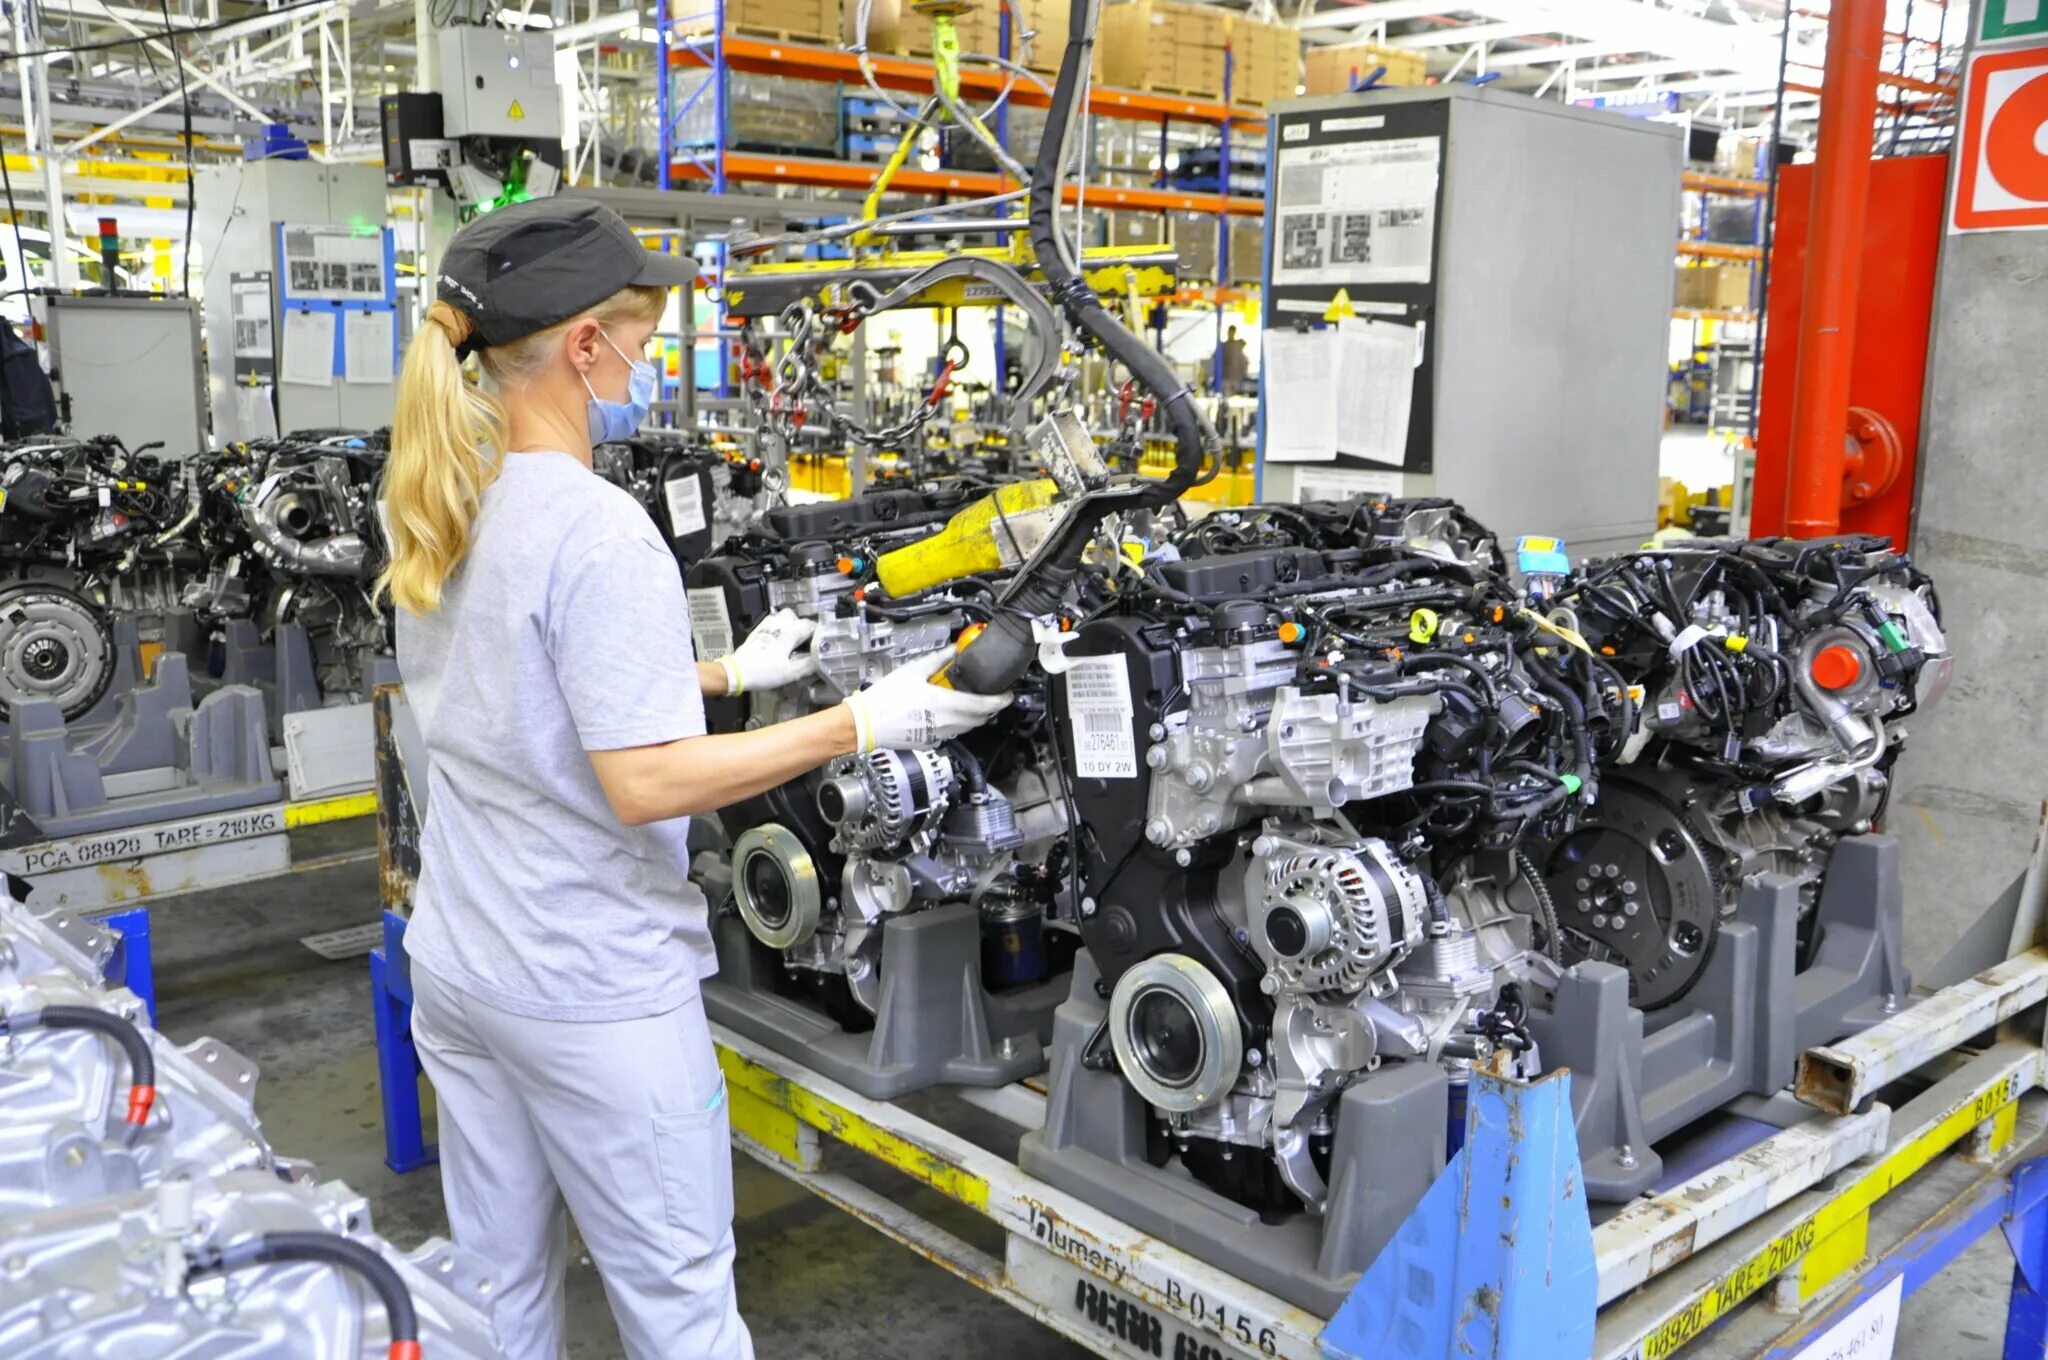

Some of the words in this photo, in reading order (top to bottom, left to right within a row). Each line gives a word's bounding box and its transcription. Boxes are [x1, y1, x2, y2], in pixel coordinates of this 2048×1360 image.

[1098, 761, 1111, 772] DY
[1115, 761, 1131, 772] 2W
[25, 849, 71, 872] PCA
[78, 838, 141, 861] 08920
[154, 825, 202, 849] TARE
[219, 820, 248, 838] 210
[251, 814, 276, 831] KG
[1714, 1263, 1755, 1313] TARE
